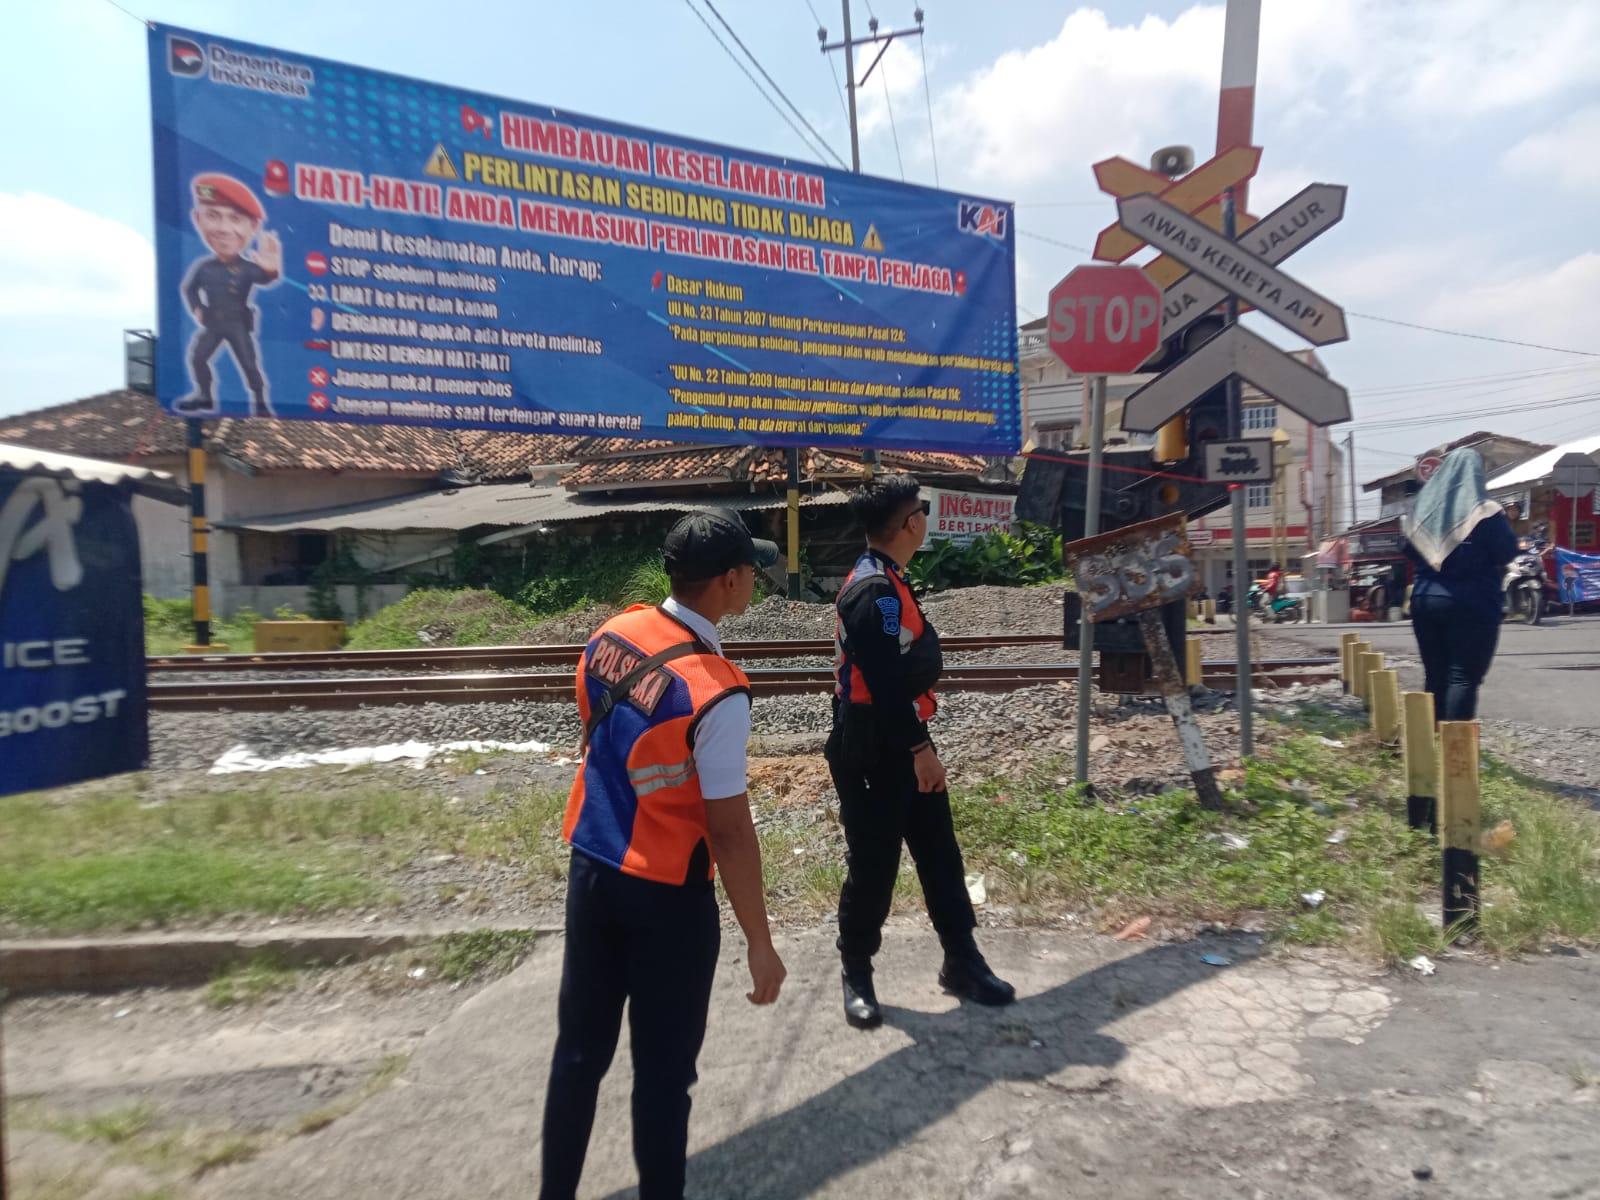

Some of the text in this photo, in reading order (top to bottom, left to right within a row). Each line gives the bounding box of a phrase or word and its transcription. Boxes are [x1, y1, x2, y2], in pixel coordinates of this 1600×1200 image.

[210, 46, 312, 80] Danantara
[211, 63, 306, 96] Indonesia
[501, 112, 825, 207] HIMBAUAN KESELAMATAN
[464, 152, 855, 246] PERLINTASAN SEBIDANG TIDAK DIJAGA
[299, 165, 953, 293] HATI-HATI! ANDA MEMASUKI PERLINTASAN REL TANPA PENJAGA
[959, 202, 1005, 237] KAI
[329, 222, 602, 282] Demi keselamatan Anda, harap:
[1140, 209, 1325, 328] AWAS KERETA API
[1161, 200, 1326, 327] JALUR UA
[331, 255, 372, 278] STOP
[437, 270, 497, 293] melintas
[667, 274, 743, 301] Dasar Hukum
[331, 284, 498, 320] LIHAT ke kiri dan kanan
[667, 301, 682, 316] UU
[683, 303, 699, 319] No.
[700, 305, 713, 320] 23
[714, 306, 742, 324] Tahun
[743, 309, 766, 327] 2007
[768, 313, 802, 332] tentang
[1051, 294, 1159, 344] STOP
[474, 327, 499, 345] ada
[501, 329, 546, 349] kereta
[549, 335, 602, 355] melintas
[699, 327, 758, 347] perpotongan
[802, 340, 842, 358] pengguna
[843, 344, 863, 359] jalan
[445, 348, 511, 372] HATI-HATI
[434, 378, 513, 398] menerobos
[689, 366, 704, 383] No.
[706, 368, 719, 383] 22
[720, 369, 747, 386] Tahun
[749, 372, 773, 388] 2009
[774, 374, 806, 391] tentang
[807, 377, 825, 392] Lalu
[825, 378, 850, 394] Lintas
[850, 381, 865, 395] dan
[864, 382, 901, 399] Angkutan
[668, 387, 726, 407] "Pengemudi
[727, 393, 750, 410] yang
[751, 394, 773, 410] akan
[774, 396, 812, 412] melintasi
[811, 398, 858, 415] perlintasan
[454, 405, 486, 423] saat
[488, 405, 556, 426] terdengar
[558, 412, 596, 428] suara
[597, 412, 642, 431] kereta!
[666, 411, 700, 429] palang
[701, 413, 737, 432] ditutup,
[738, 416, 758, 431] atau
[758, 417, 774, 432] ada
[807, 420, 827, 435] dari
[938, 493, 1012, 517] INGAT!!!
[3, 638, 91, 669] ICE
